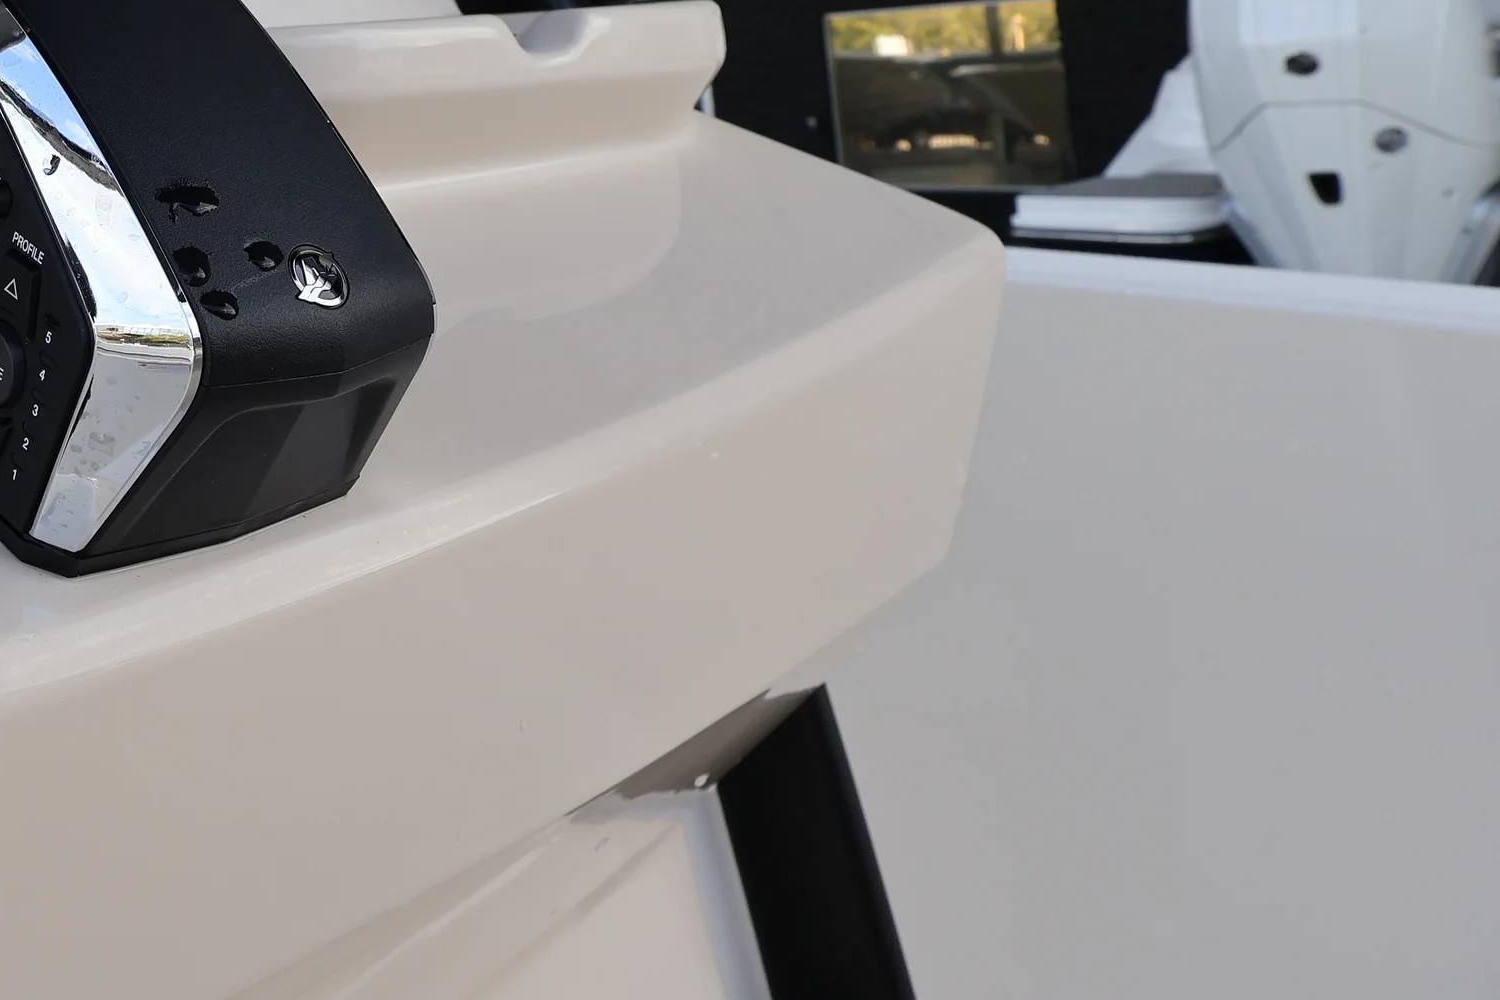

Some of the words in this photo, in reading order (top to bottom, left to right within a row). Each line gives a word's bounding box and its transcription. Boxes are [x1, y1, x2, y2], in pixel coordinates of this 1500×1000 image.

[12, 231, 45, 265] PROFILE
[45, 330, 52, 344] 5
[39, 369, 46, 382] 4
[32, 404, 39, 417] 3
[22, 437, 29, 451] 2
[11, 468, 18, 481] 1
